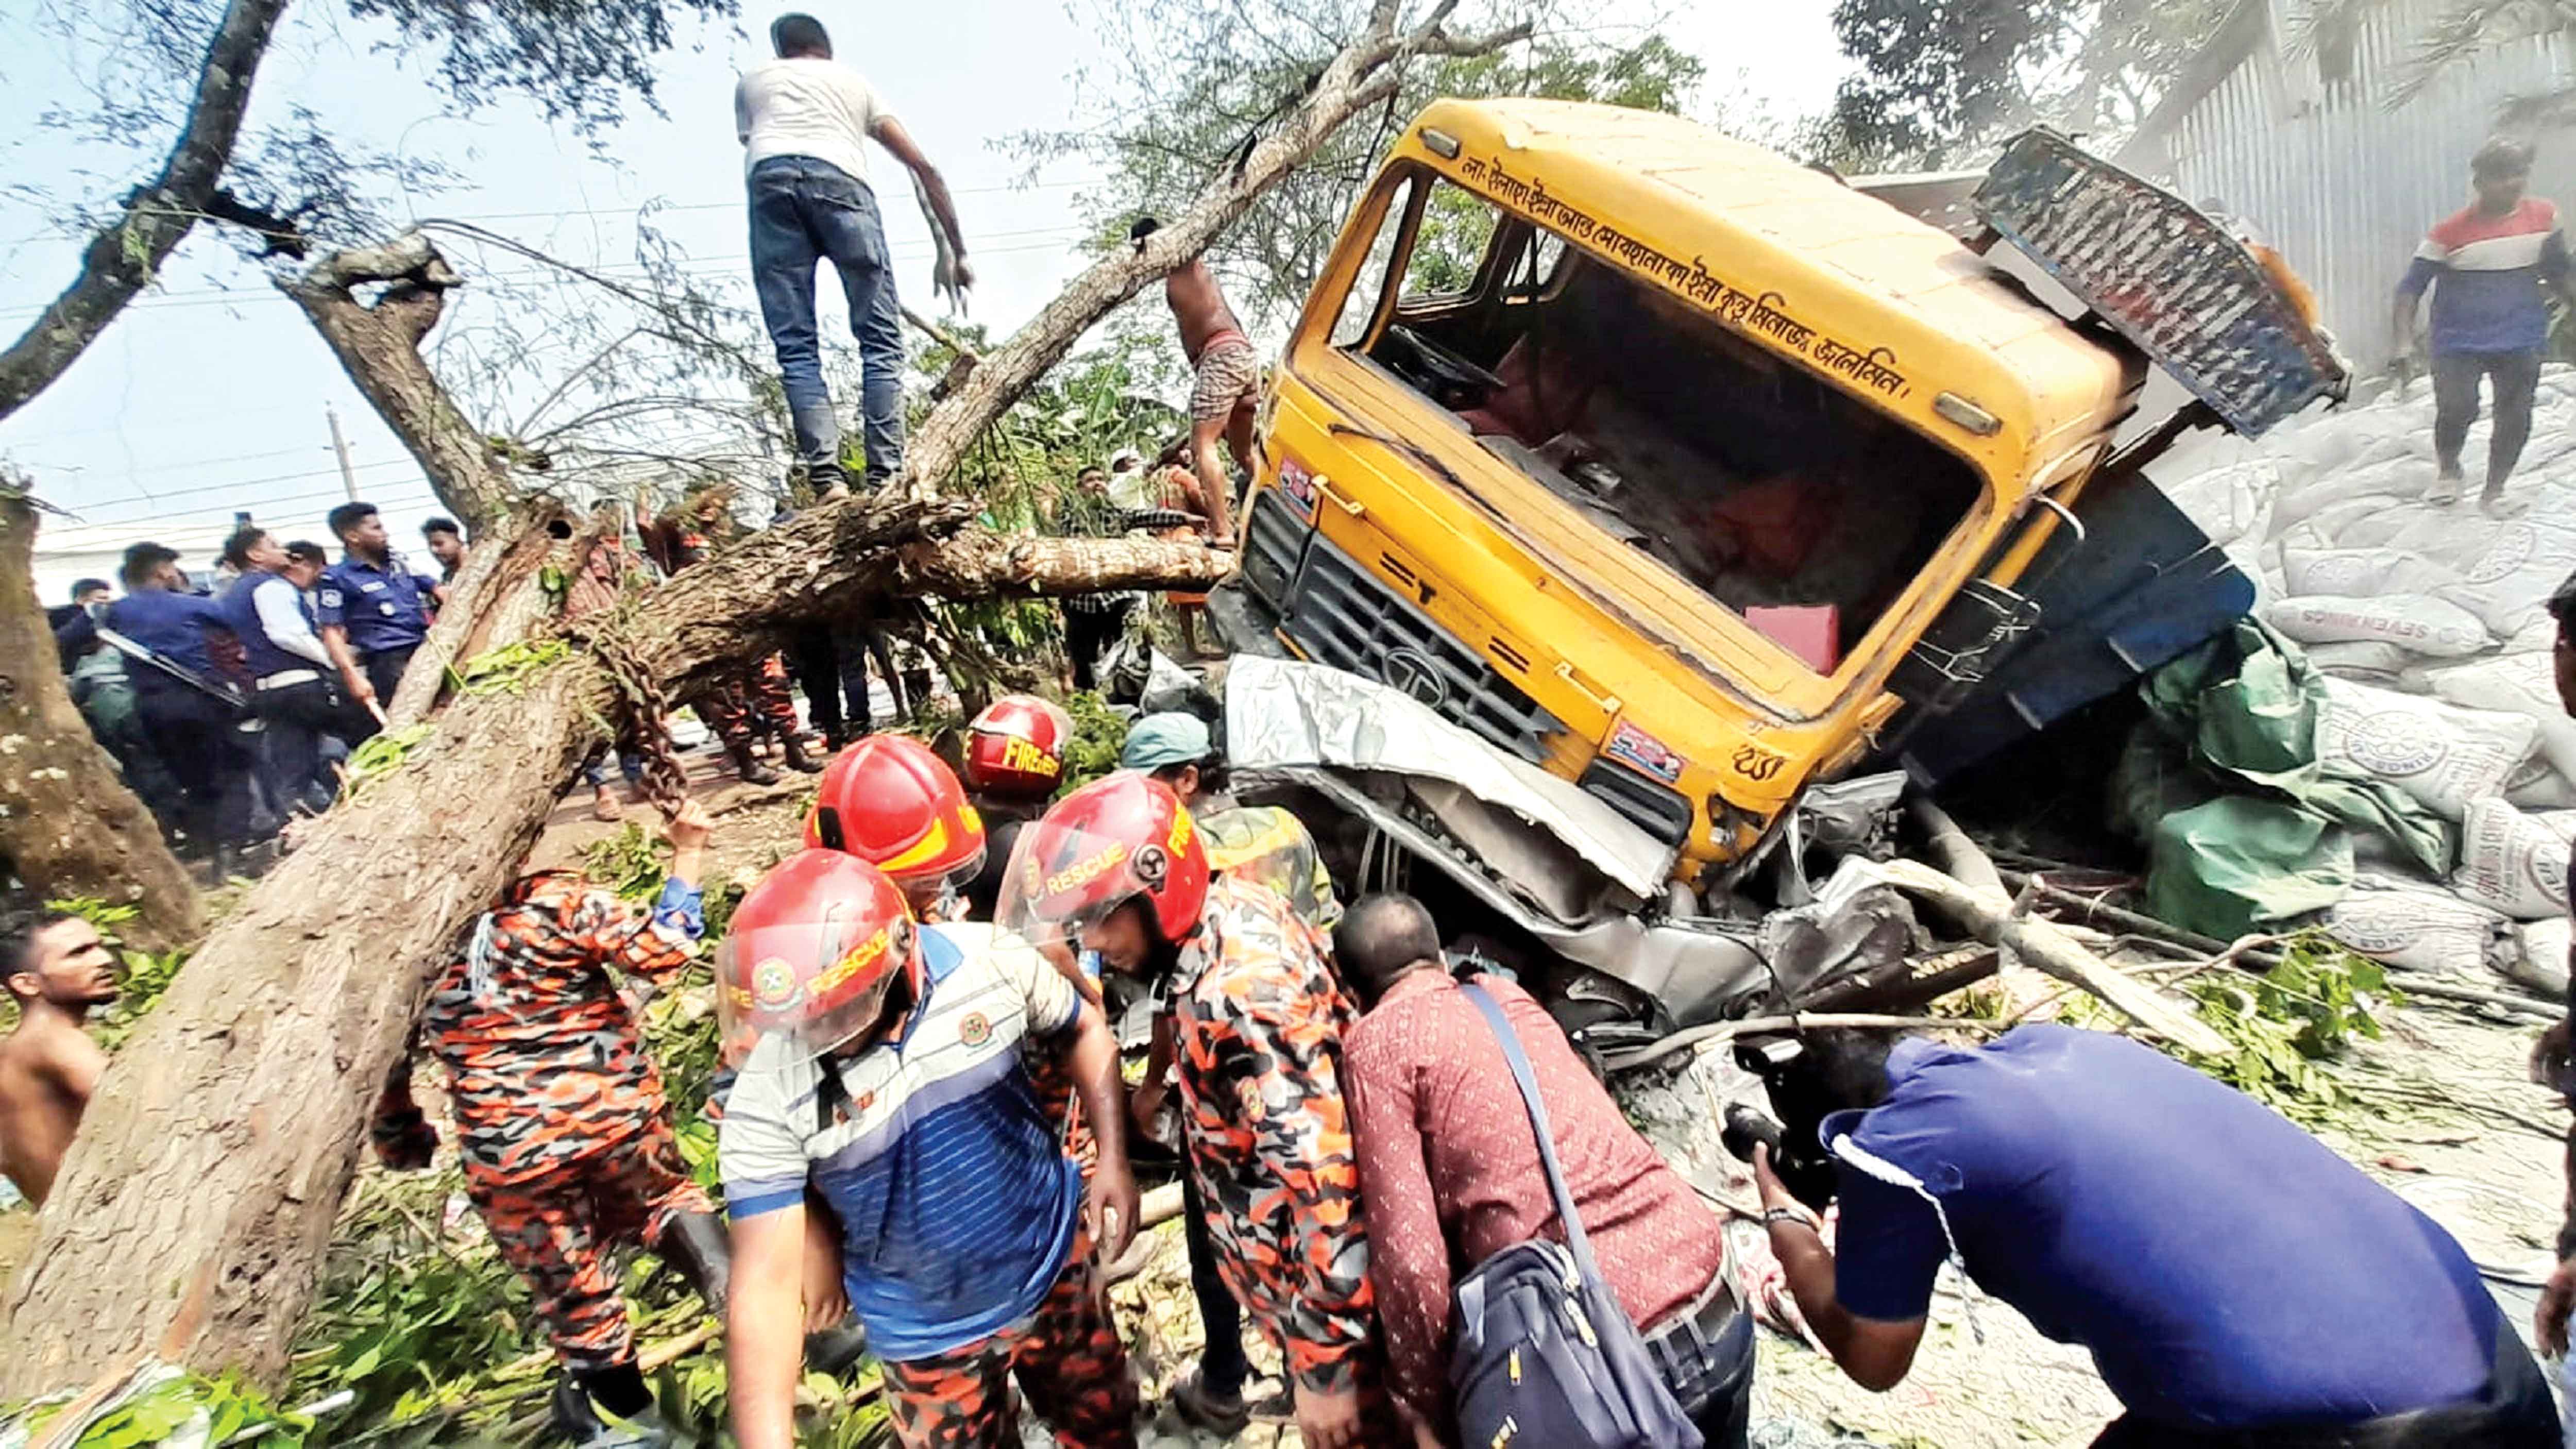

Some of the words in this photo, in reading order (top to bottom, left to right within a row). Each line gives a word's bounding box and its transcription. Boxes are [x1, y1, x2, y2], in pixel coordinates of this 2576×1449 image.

[1002, 734, 1042, 774] FIRE
[1045, 839, 1128, 897] RESCUE
[806, 928, 891, 996] RESCUE
